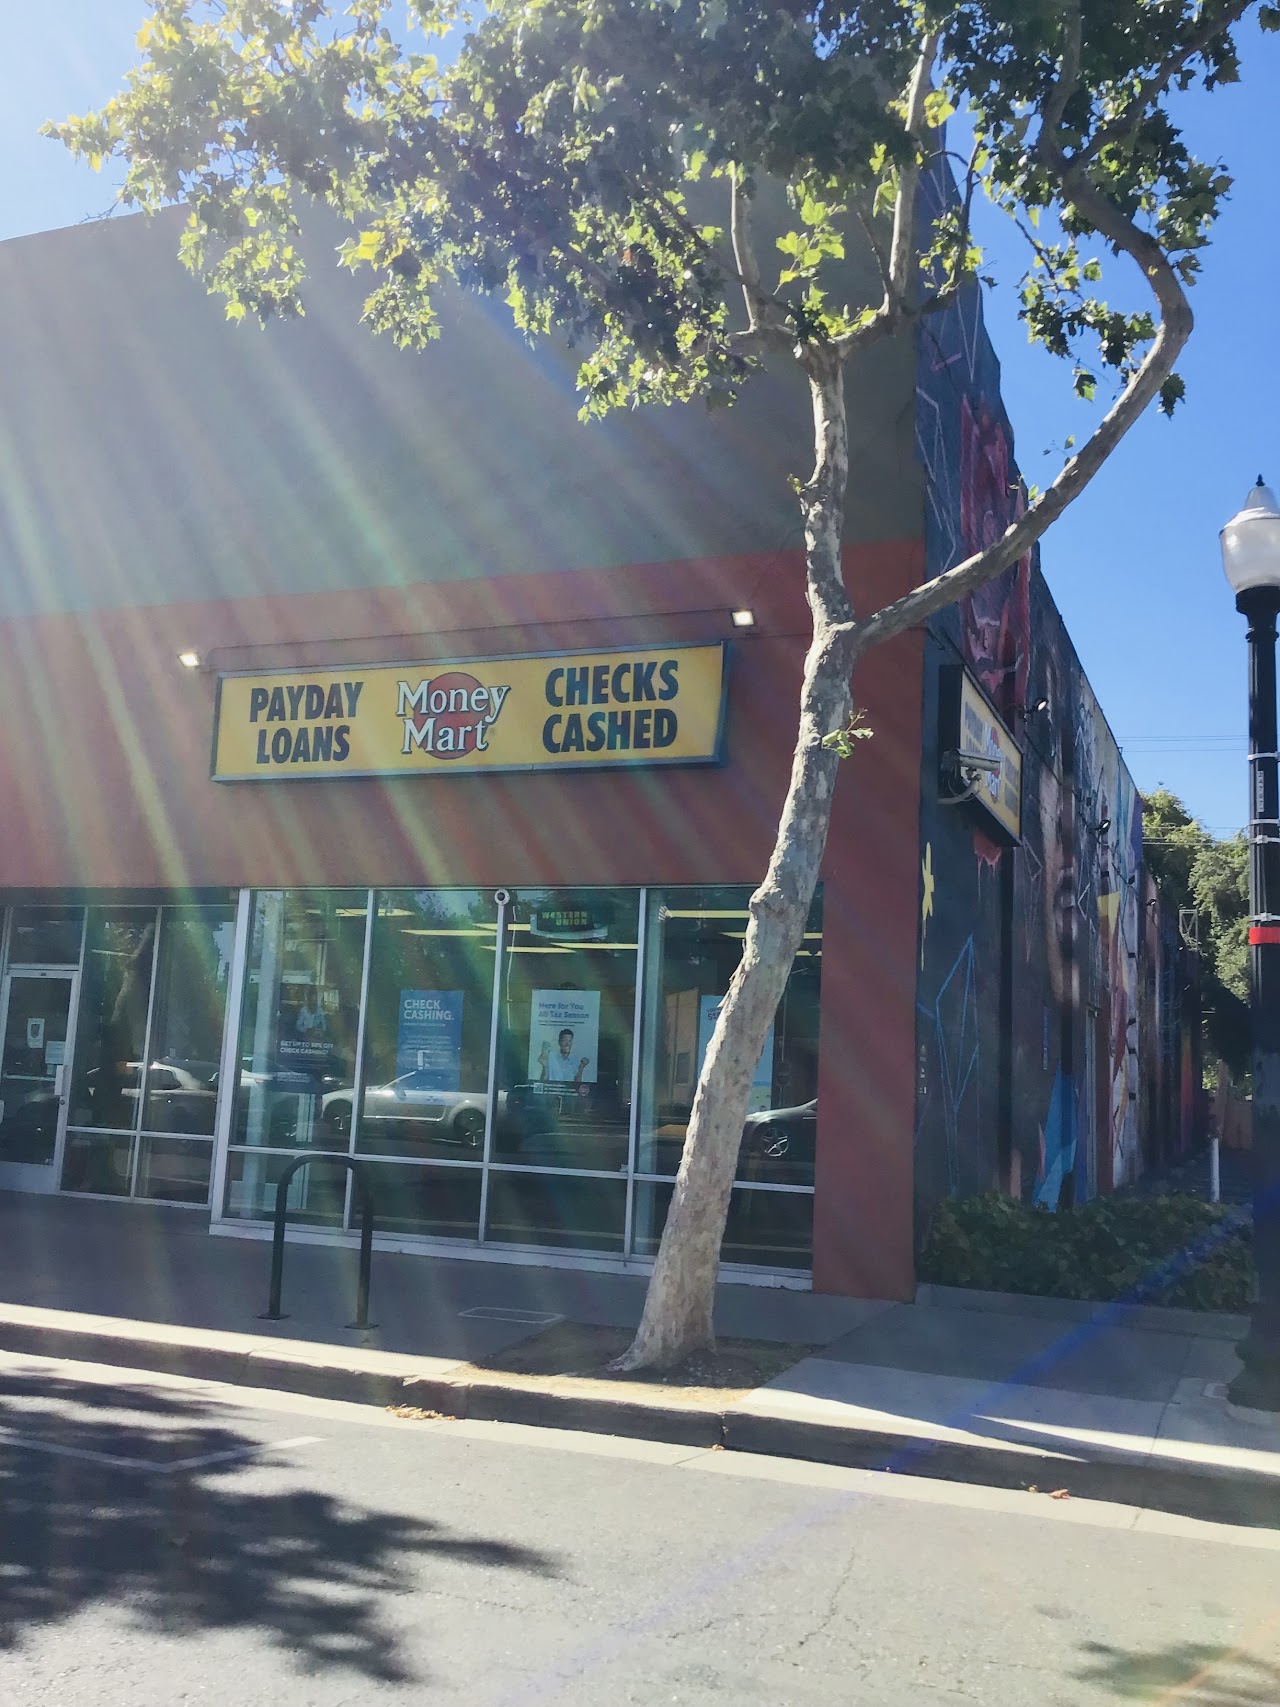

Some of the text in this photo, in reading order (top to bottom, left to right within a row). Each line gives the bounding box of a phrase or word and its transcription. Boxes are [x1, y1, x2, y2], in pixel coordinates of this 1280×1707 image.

[249, 681, 364, 722] PAYDAY
[396, 679, 511, 725] Money
[545, 660, 679, 707] CHECKS
[256, 724, 350, 764] LOANS
[401, 717, 489, 754] Mart
[542, 708, 678, 753] CASHED
[541, 911, 588, 919] WESTERN
[403, 1010, 455, 1021] CASHING.
[404, 999, 441, 1010] CHECK
[539, 1002, 557, 1010] Here
